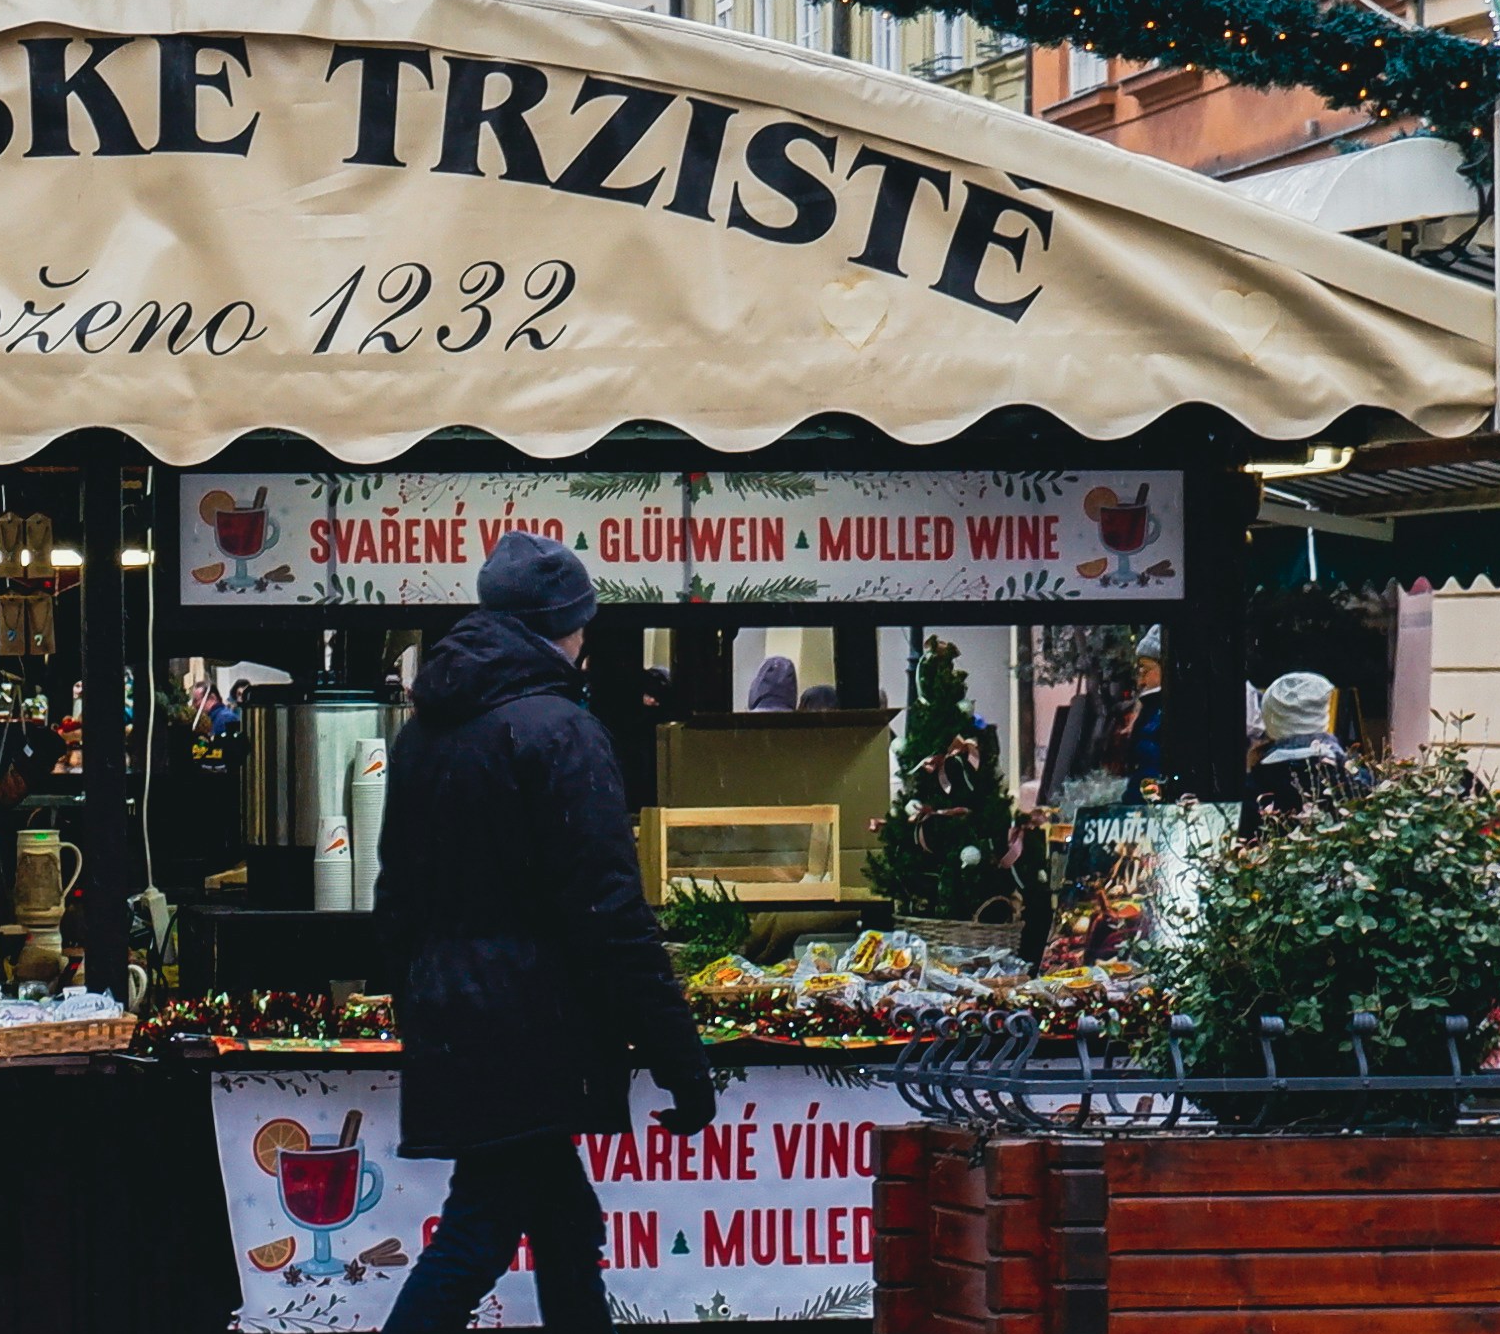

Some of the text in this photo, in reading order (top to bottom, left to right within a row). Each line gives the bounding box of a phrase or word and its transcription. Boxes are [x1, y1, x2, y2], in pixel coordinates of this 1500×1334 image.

[308, 259, 578, 355] 1232
[309, 501, 468, 565] SVAŘENÉ
[599, 507, 785, 564] GLÜHWEIN
[818, 516, 955, 563] MULLED
[966, 515, 1061, 561] WINE
[570, 1101, 875, 1183] VAŘENÉ VÍNO
[703, 1207, 875, 1268] MULLED
